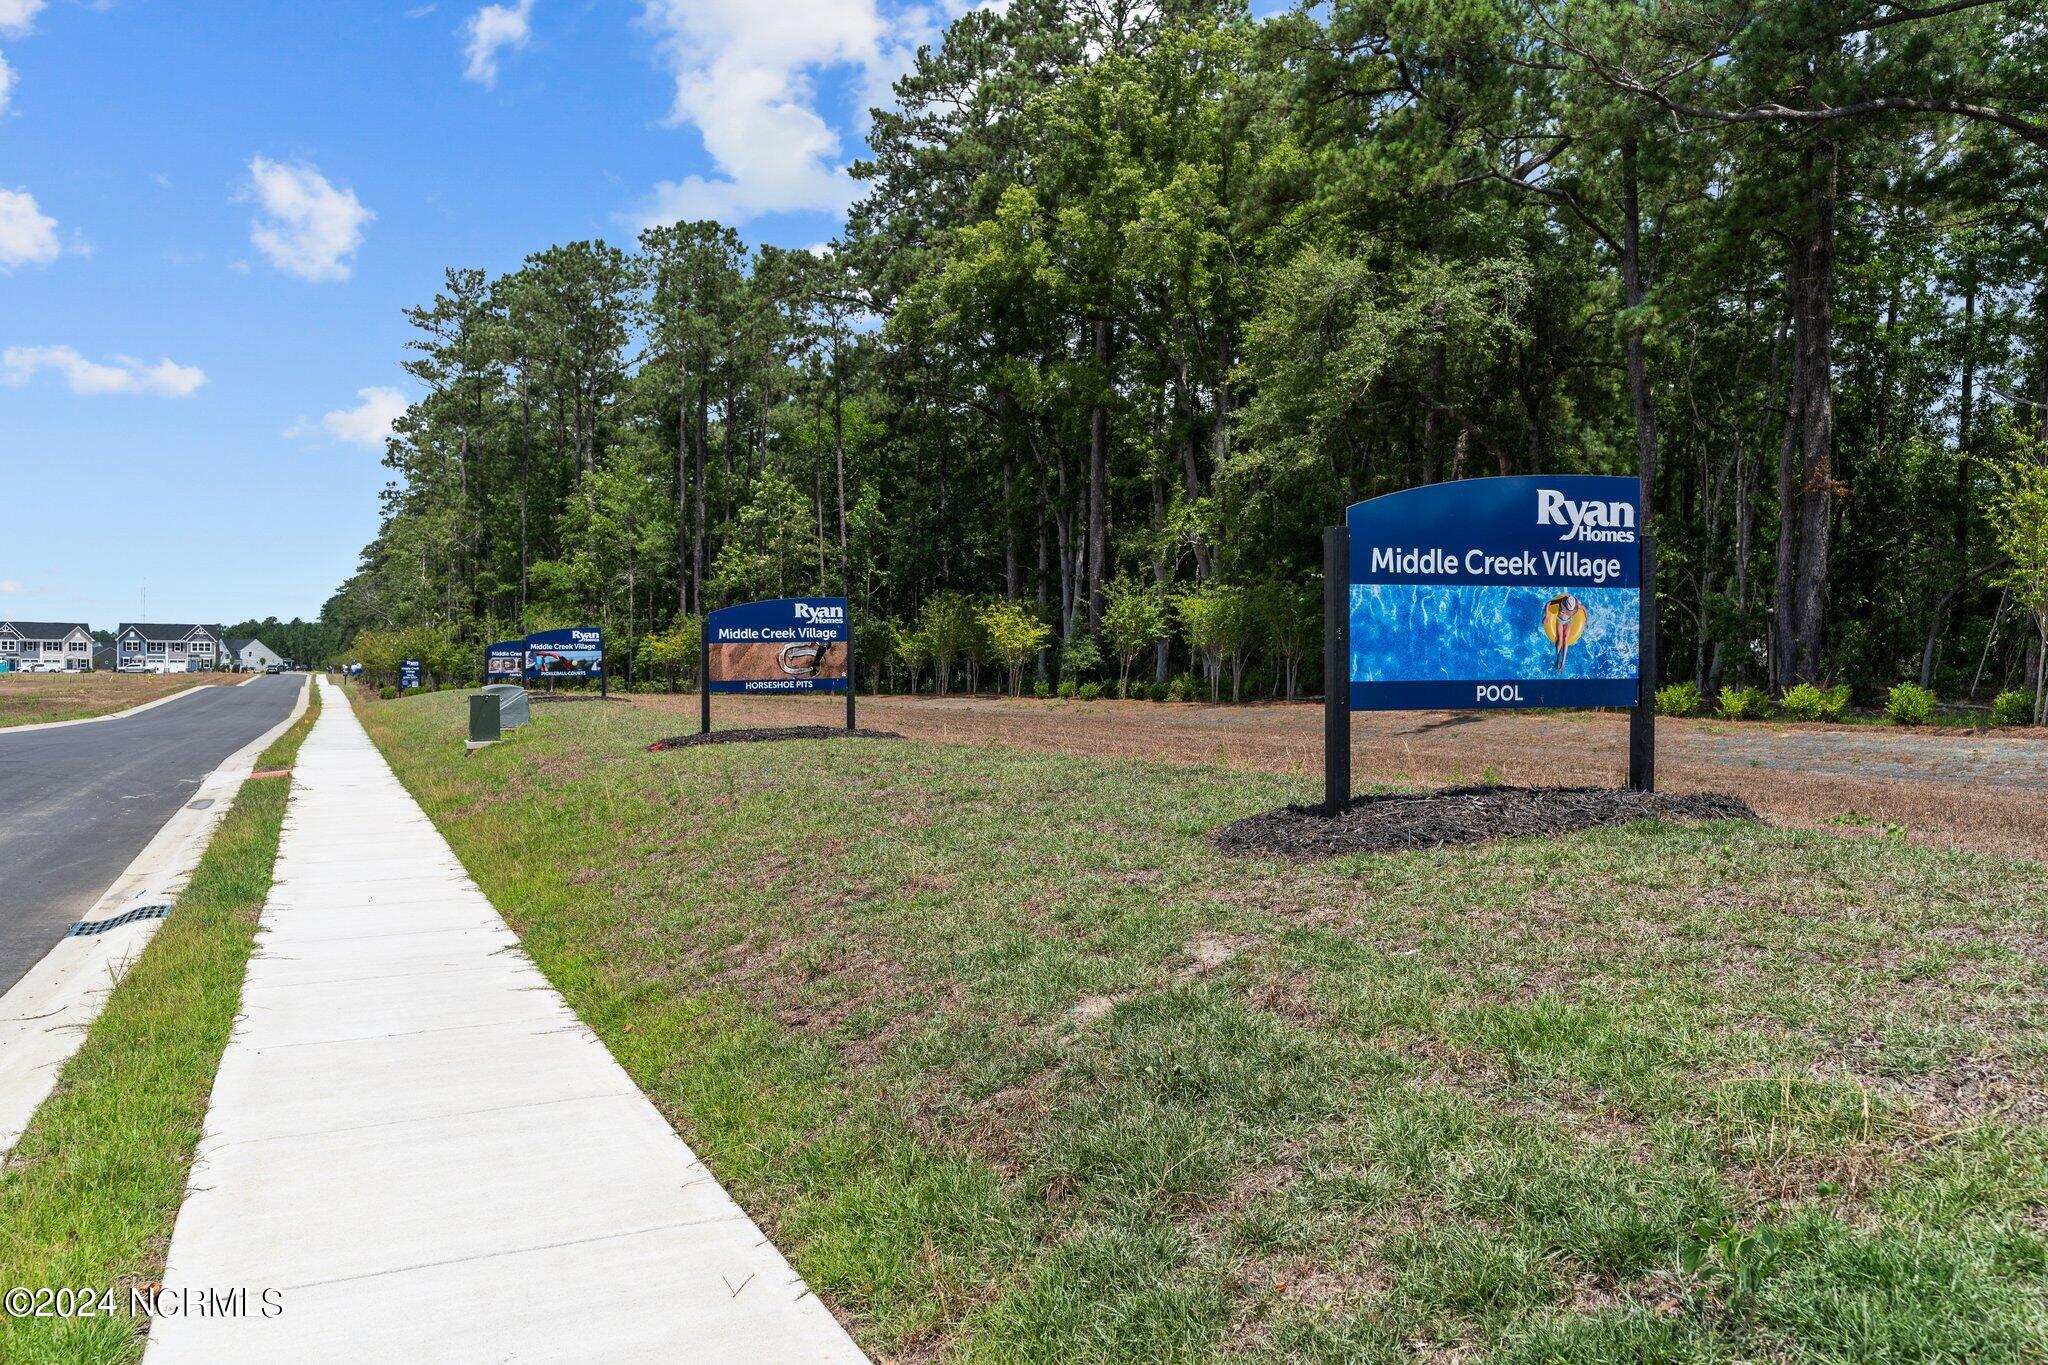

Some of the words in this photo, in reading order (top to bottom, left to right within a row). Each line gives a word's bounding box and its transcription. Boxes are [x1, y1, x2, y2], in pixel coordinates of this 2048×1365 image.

[1537, 489, 1635, 541] Ryan
[1578, 526, 1635, 543] Homes
[1371, 547, 1459, 574] Middle
[1465, 549, 1537, 575] Creek
[1542, 551, 1621, 583] Village
[794, 603, 843, 624] Ryan
[572, 630, 599, 642] Ryan
[718, 628, 759, 639] Middle
[761, 628, 796, 639] Creek
[797, 628, 837, 640] Village
[574, 643, 595, 651] Village
[745, 681, 795, 690] HORSESHOE
[796, 680, 813, 688] PITS
[1476, 685, 1523, 702] POOL
